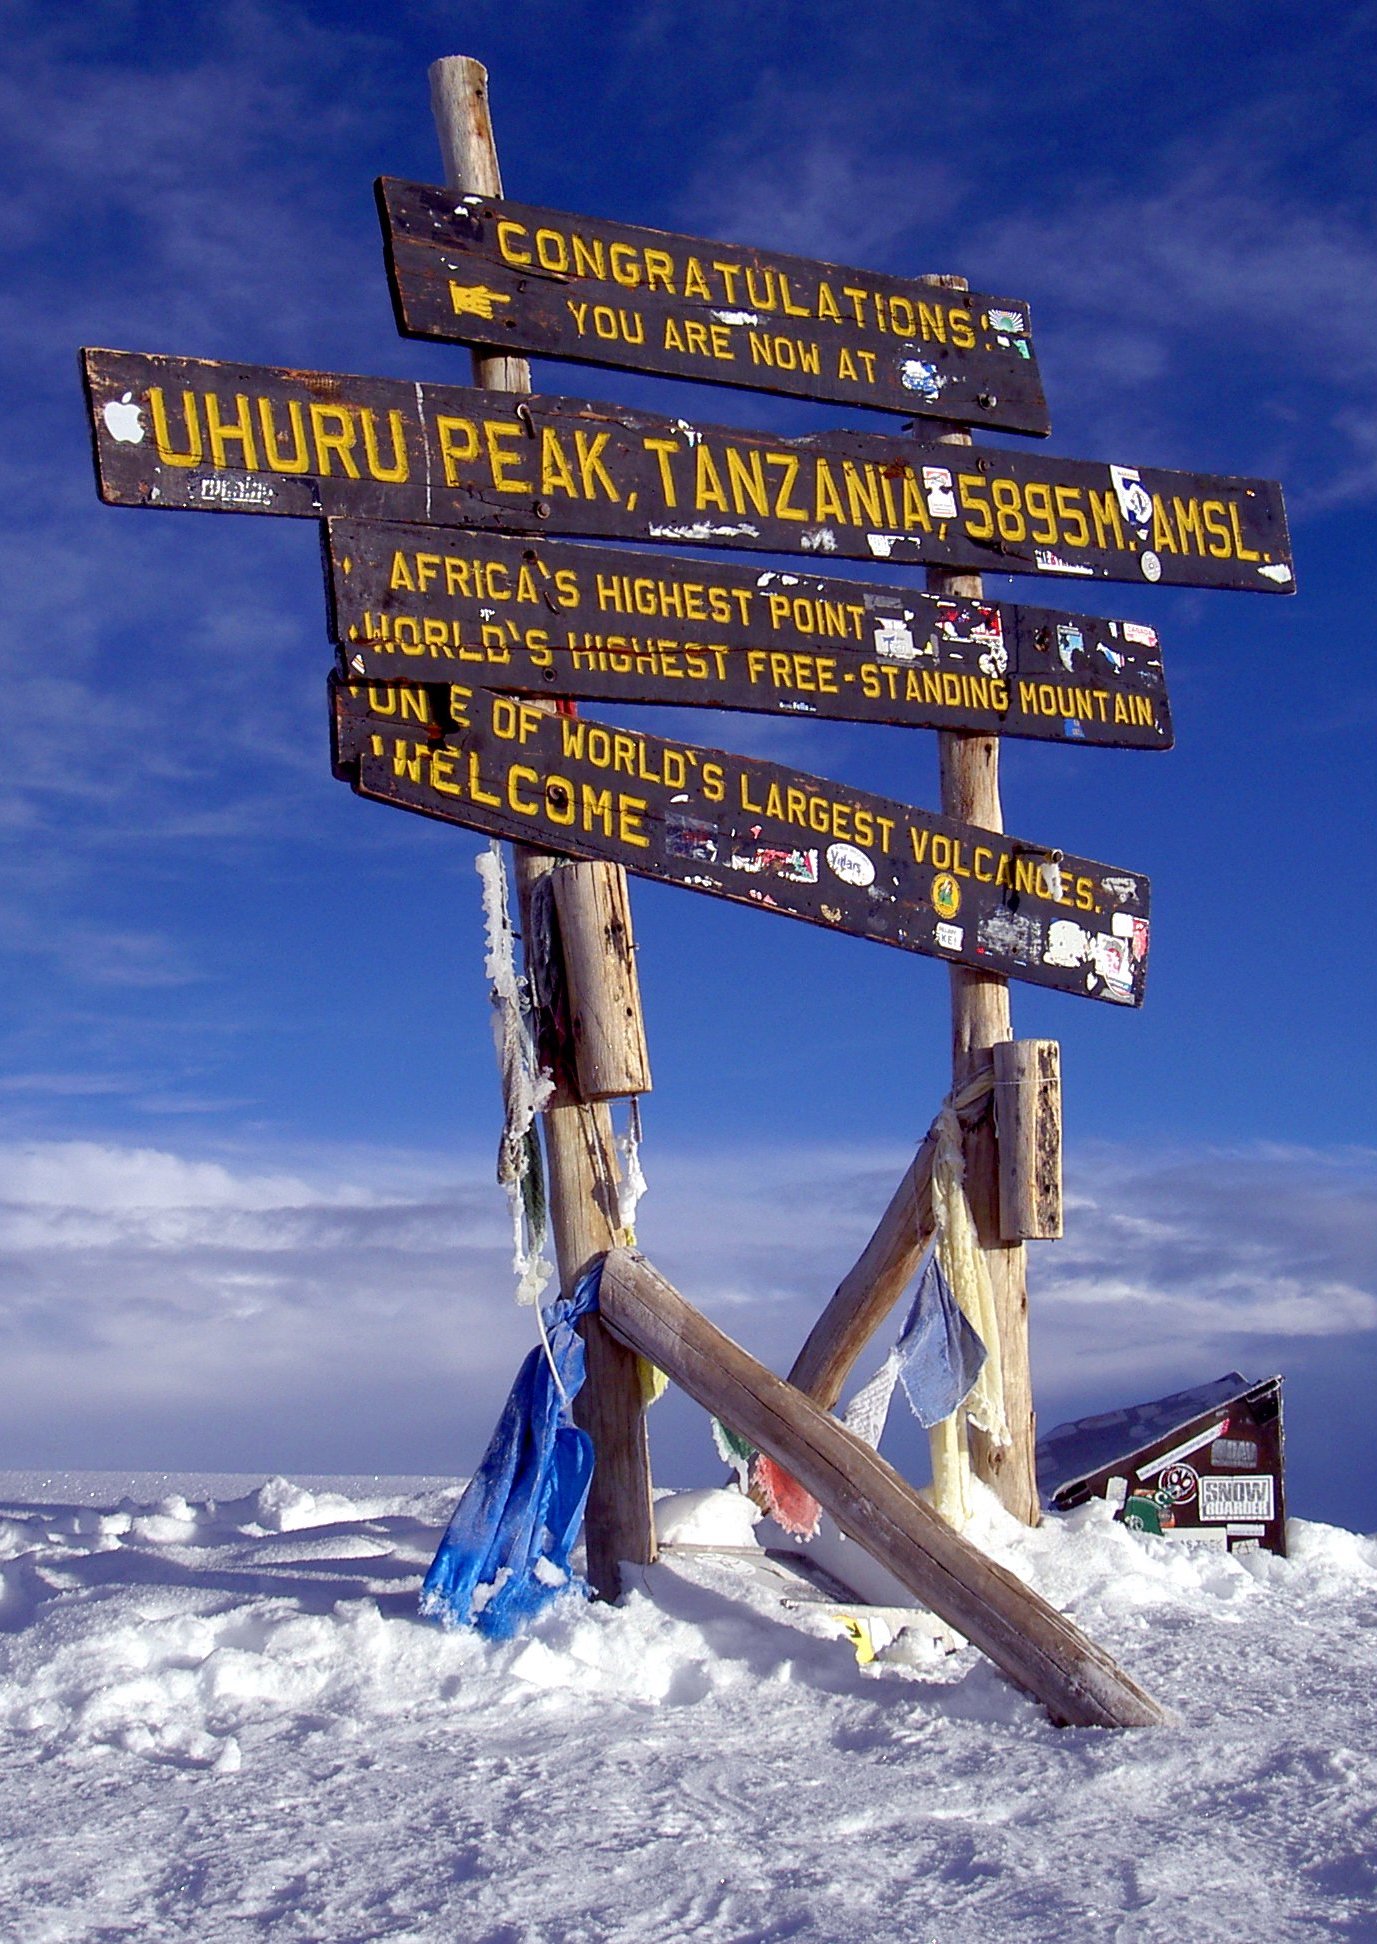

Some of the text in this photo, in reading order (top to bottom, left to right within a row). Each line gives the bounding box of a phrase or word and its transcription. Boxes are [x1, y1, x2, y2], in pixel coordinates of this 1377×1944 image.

[567, 299, 877, 384] YOU ARE NOW AT
[149, 386, 1272, 564] UHURU PEAK, TANZANIA, 5895M. AMSL.
[389, 550, 865, 640] AFRICA'S HIGHEST POINT
[363, 610, 554, 667] WORLD'S
[567, 631, 729, 681] HIGHEST
[1018, 681, 1154, 727] MOUNTAIN
[371, 733, 650, 848] WELCOME
[492, 698, 545, 745] OF
[561, 718, 725, 801] WORLD'S
[740, 773, 896, 854] LARGEST
[1205, 1481, 1267, 1502] SNOW
